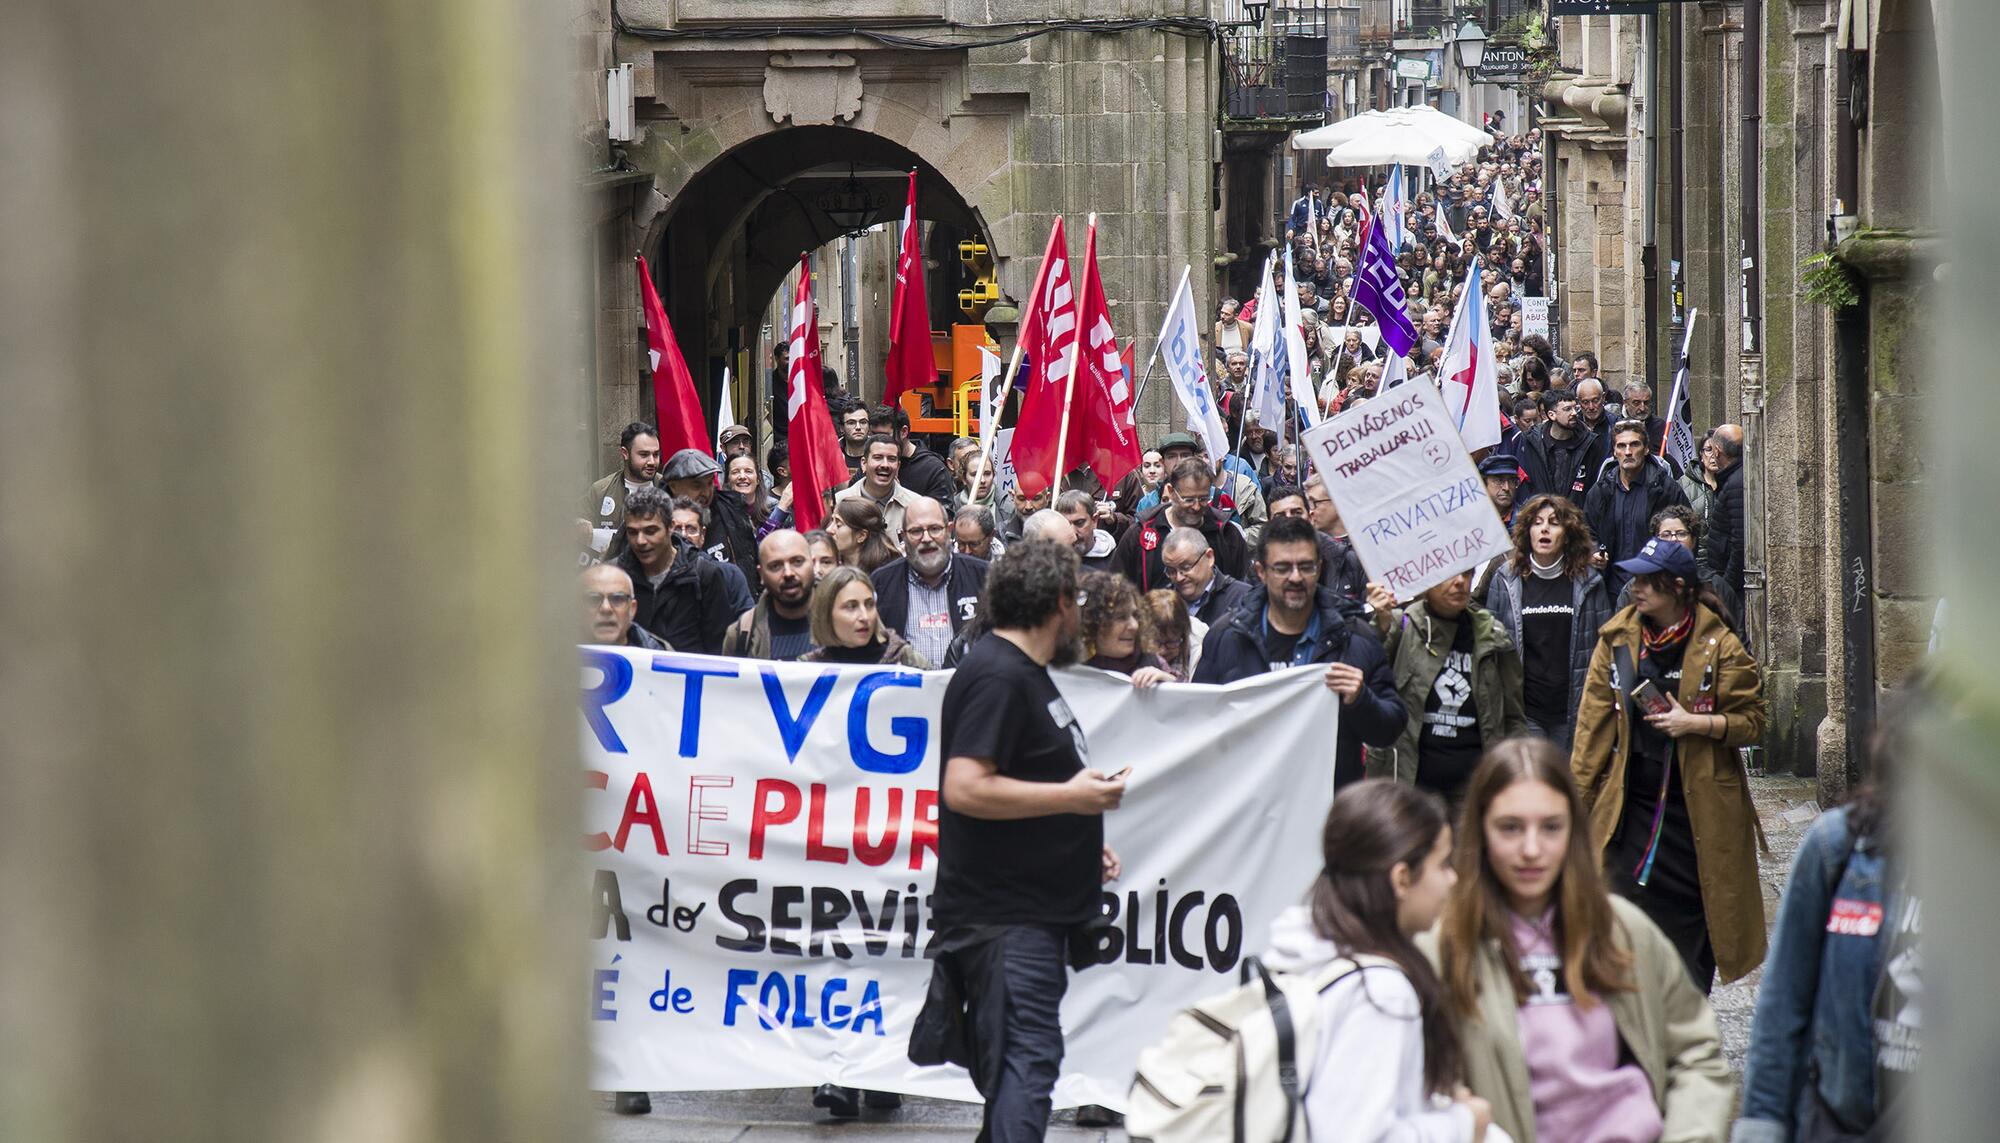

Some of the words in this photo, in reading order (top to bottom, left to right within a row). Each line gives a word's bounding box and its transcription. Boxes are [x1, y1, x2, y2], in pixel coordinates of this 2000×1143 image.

[1482, 51, 1525, 62] ANTON
[1321, 393, 1425, 457] DEIXÁDENOS
[1335, 418, 1435, 479] TRABALLAR!!!
[1362, 476, 1488, 546] PRIVATIZAR
[1383, 527, 1491, 591] PREVARICAR
[687, 775, 734, 856] E
[748, 778, 939, 870] PLUR
[647, 878, 706, 933] do
[1098, 878, 1243, 974] BLICO
[650, 969, 695, 1013] de
[723, 969, 886, 1036] FOLGA
